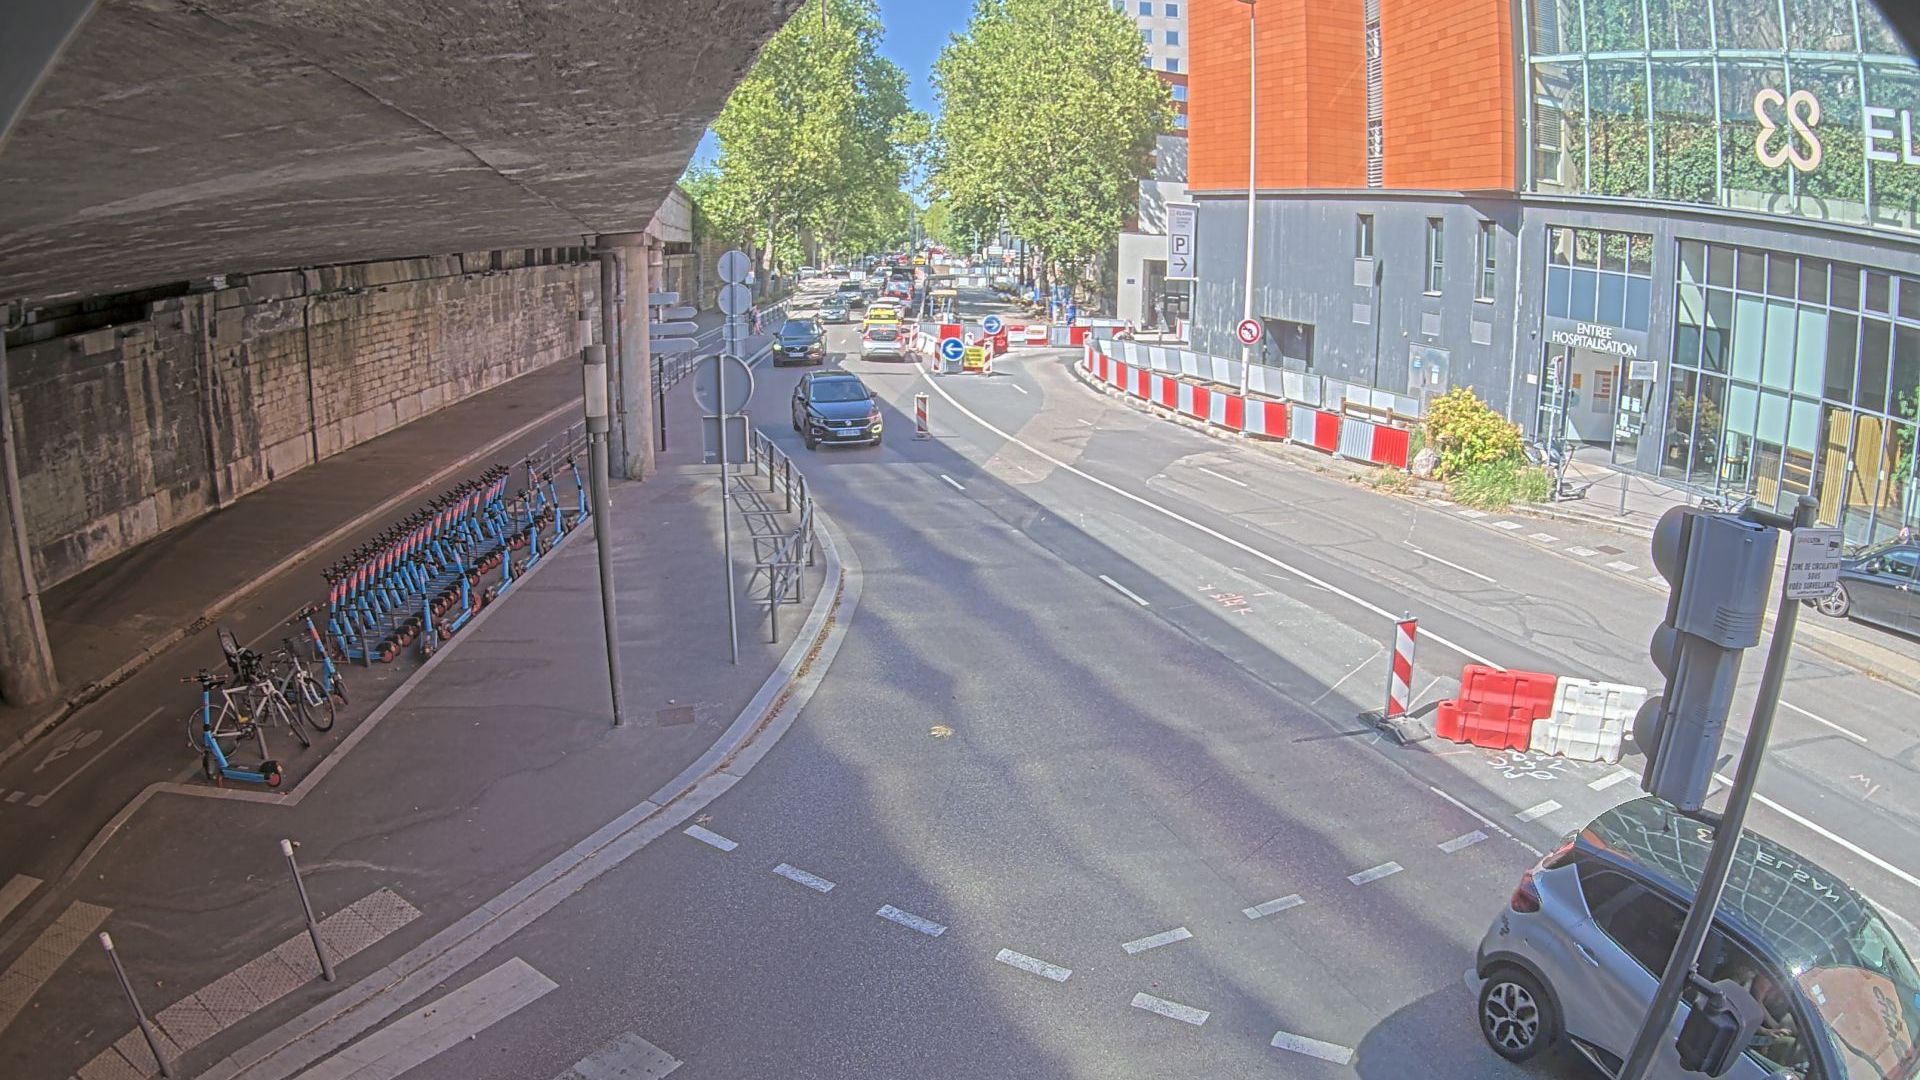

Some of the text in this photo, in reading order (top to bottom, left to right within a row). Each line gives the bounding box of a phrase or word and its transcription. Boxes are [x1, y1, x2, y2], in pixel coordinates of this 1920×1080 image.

[1864, 106, 1920, 165] EL
[1577, 323, 1613, 339] ENTREE
[1552, 331, 1637, 356] HOSPITALISATION
[1792, 562, 1839, 571] ZONE DE CIRCULATION
[1808, 572, 1821, 580] SOUS
[1804, 581, 1836, 590] SURVEILLANCE
